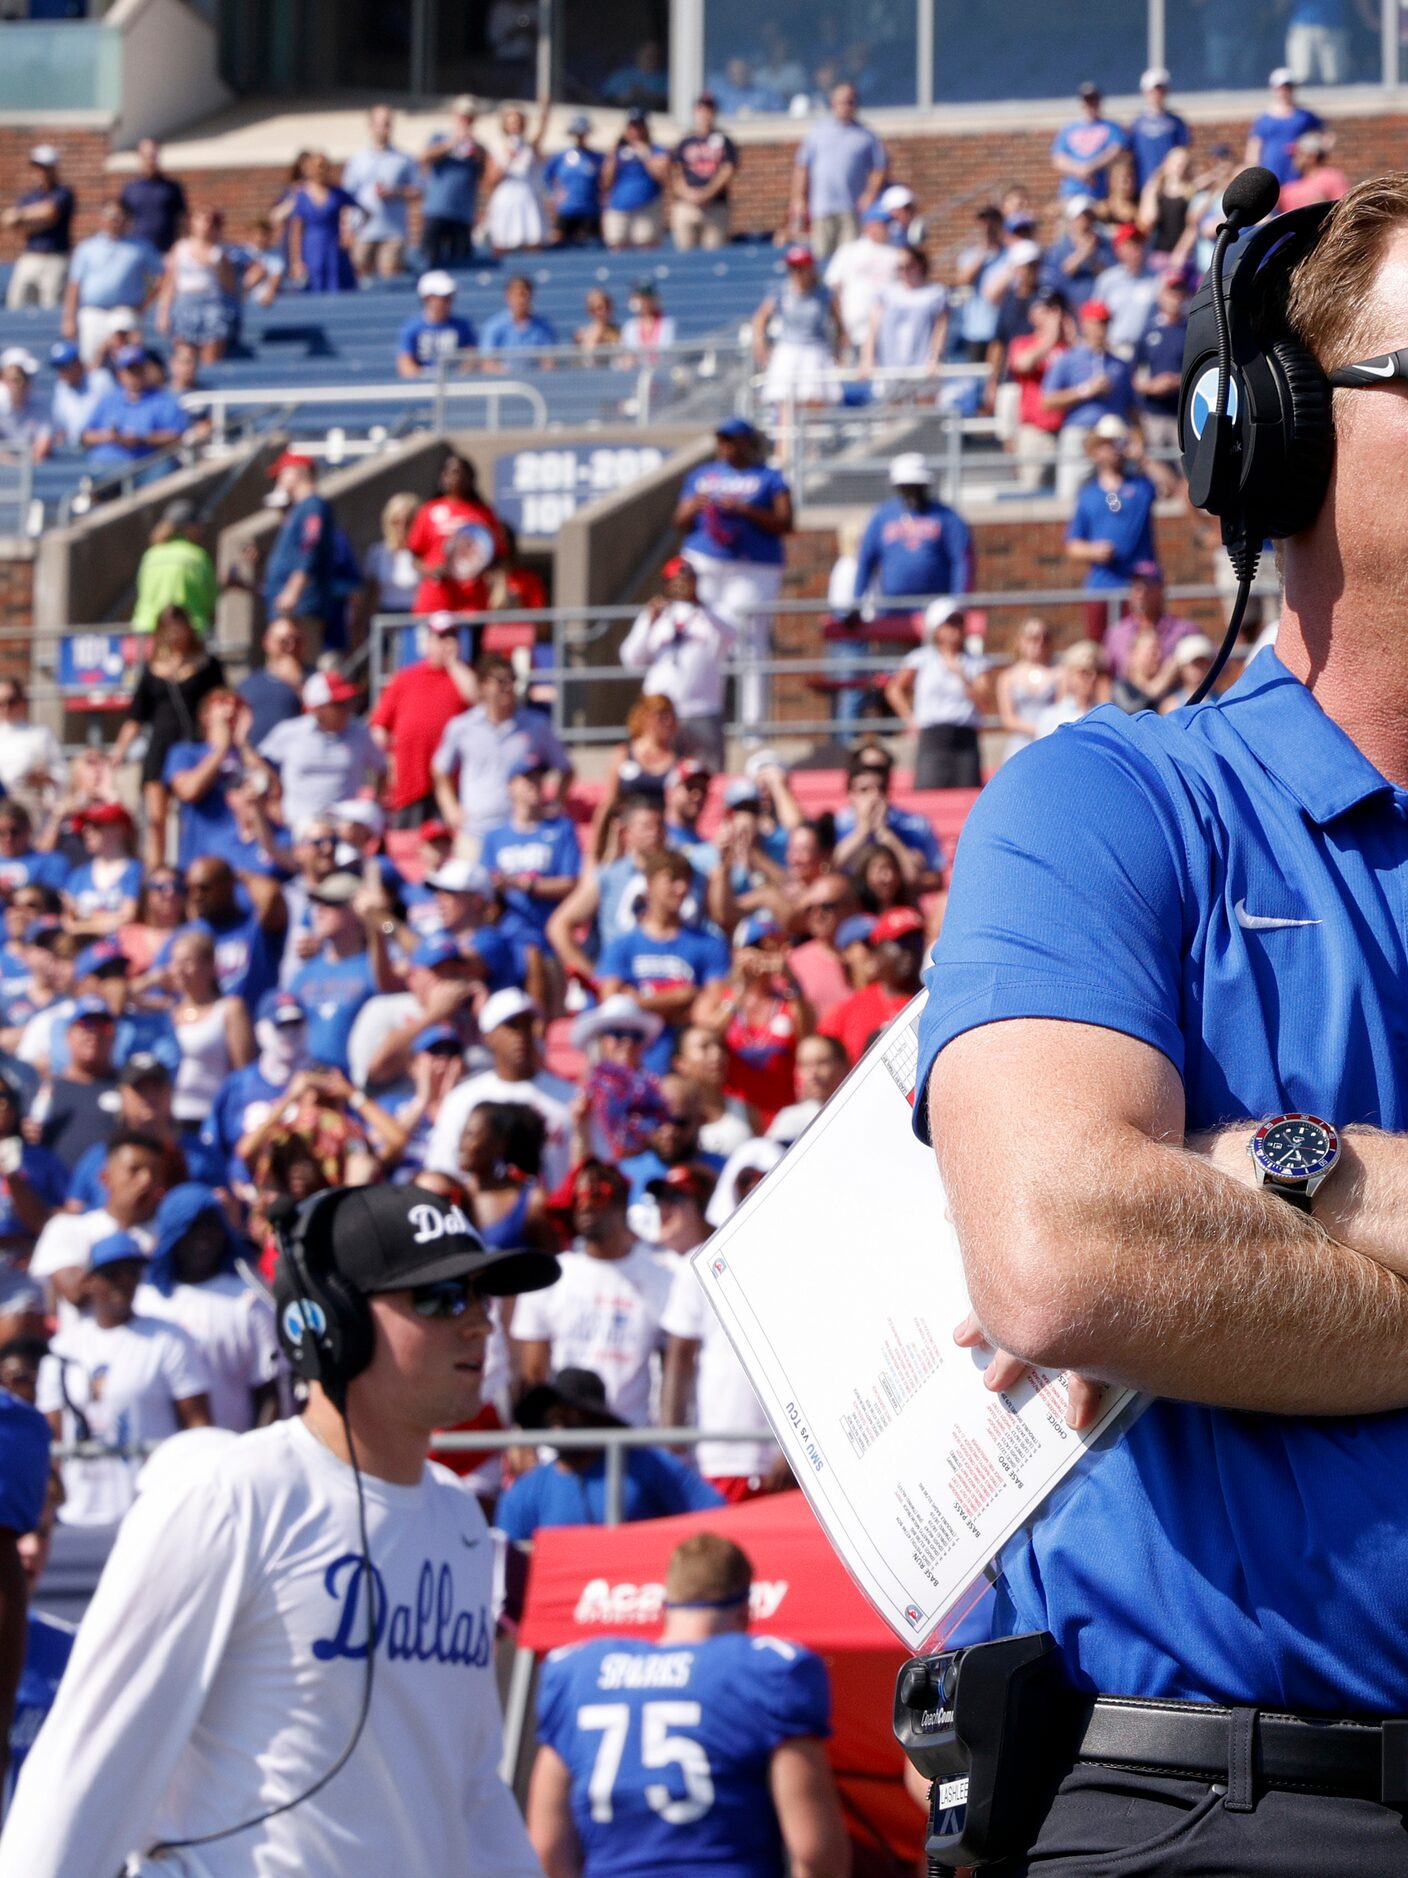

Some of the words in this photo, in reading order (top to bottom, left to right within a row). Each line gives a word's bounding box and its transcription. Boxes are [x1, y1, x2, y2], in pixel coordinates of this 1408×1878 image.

[786, 1402, 802, 1429] TCU
[800, 1427, 809, 1442] vs
[1047, 1414, 1067, 1439] CHOICE:
[806, 1444, 824, 1472] SMU
[998, 1456, 1010, 1471] RPO:
[1009, 1471, 1023, 1488] BASE
[954, 1502, 968, 1520] PASS:
[966, 1520, 980, 1538] BASE
[913, 1551, 925, 1569] RUN:
[924, 1569, 939, 1586] BASE
[312, 1553, 490, 1667] Dallas
[577, 1700, 715, 1825] 75
[941, 1781, 968, 1805] LASHLEE
